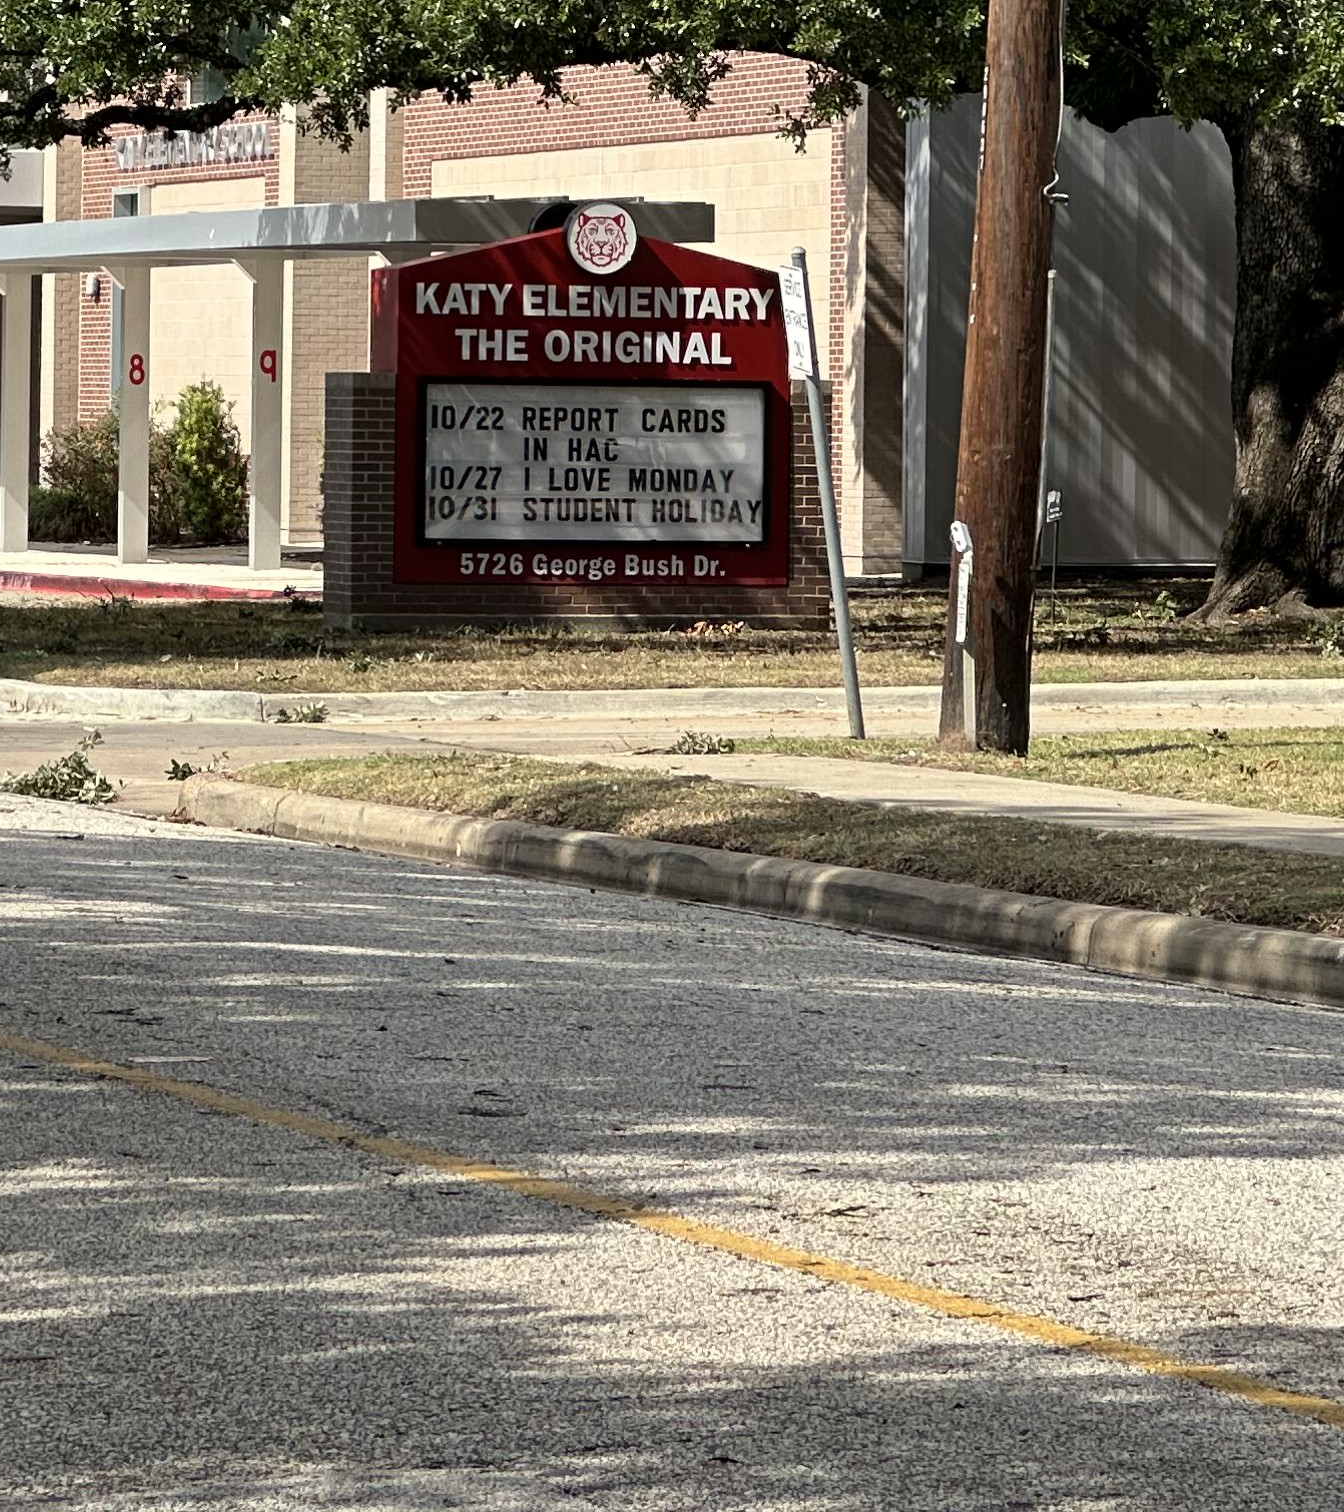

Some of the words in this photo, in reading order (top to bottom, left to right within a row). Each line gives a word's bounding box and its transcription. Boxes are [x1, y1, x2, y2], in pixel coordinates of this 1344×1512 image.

[416, 282, 513, 316] KATY
[522, 284, 775, 320] ELEMENTARY
[454, 328, 529, 362] THE
[544, 329, 732, 365] ORIGINAL
[129, 353, 145, 385] 8
[259, 349, 277, 382] 9
[431, 405, 504, 430] 10/22
[522, 406, 619, 432] REPORT
[642, 408, 725, 433] CARDS
[524, 437, 547, 461] IN
[568, 438, 619, 462] HAC
[430, 465, 502, 491] 10/27
[524, 467, 530, 491] I
[549, 467, 610, 491] LOVE
[628, 468, 735, 493] MONDAY
[429, 495, 497, 521] 10/31
[523, 497, 636, 522] STUDENT
[652, 498, 762, 523] HOLIDAY
[460, 553, 524, 575] 5726
[532, 554, 616, 581] George
[624, 554, 684, 576] Bush
[693, 554, 726, 576] Dr.
